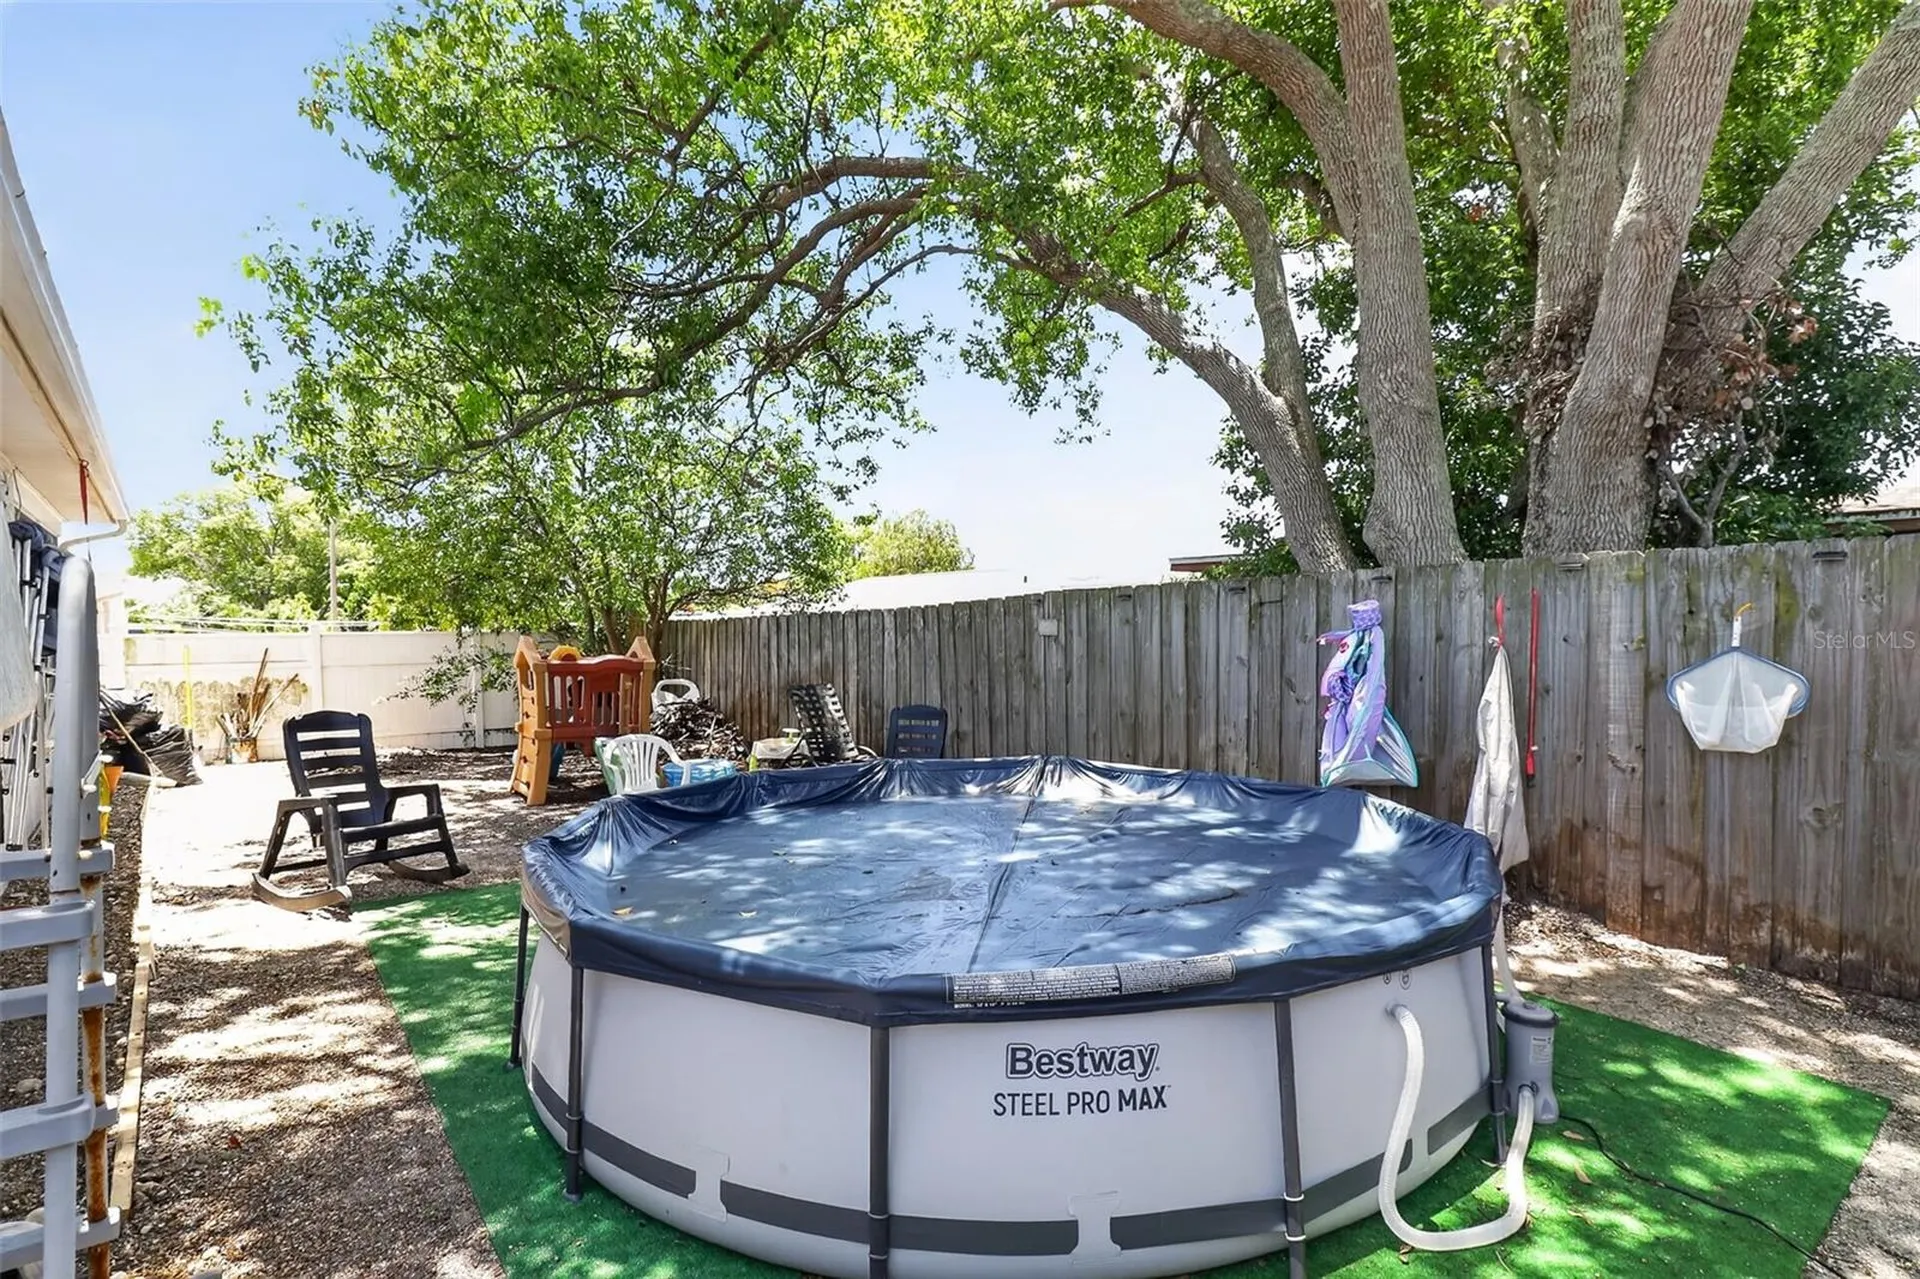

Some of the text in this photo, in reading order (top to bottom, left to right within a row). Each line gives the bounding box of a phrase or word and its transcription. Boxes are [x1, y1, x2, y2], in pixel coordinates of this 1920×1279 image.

[1007, 1043, 1158, 1081] Bestway
[993, 1085, 1167, 1116] STEEL PRO MAX
